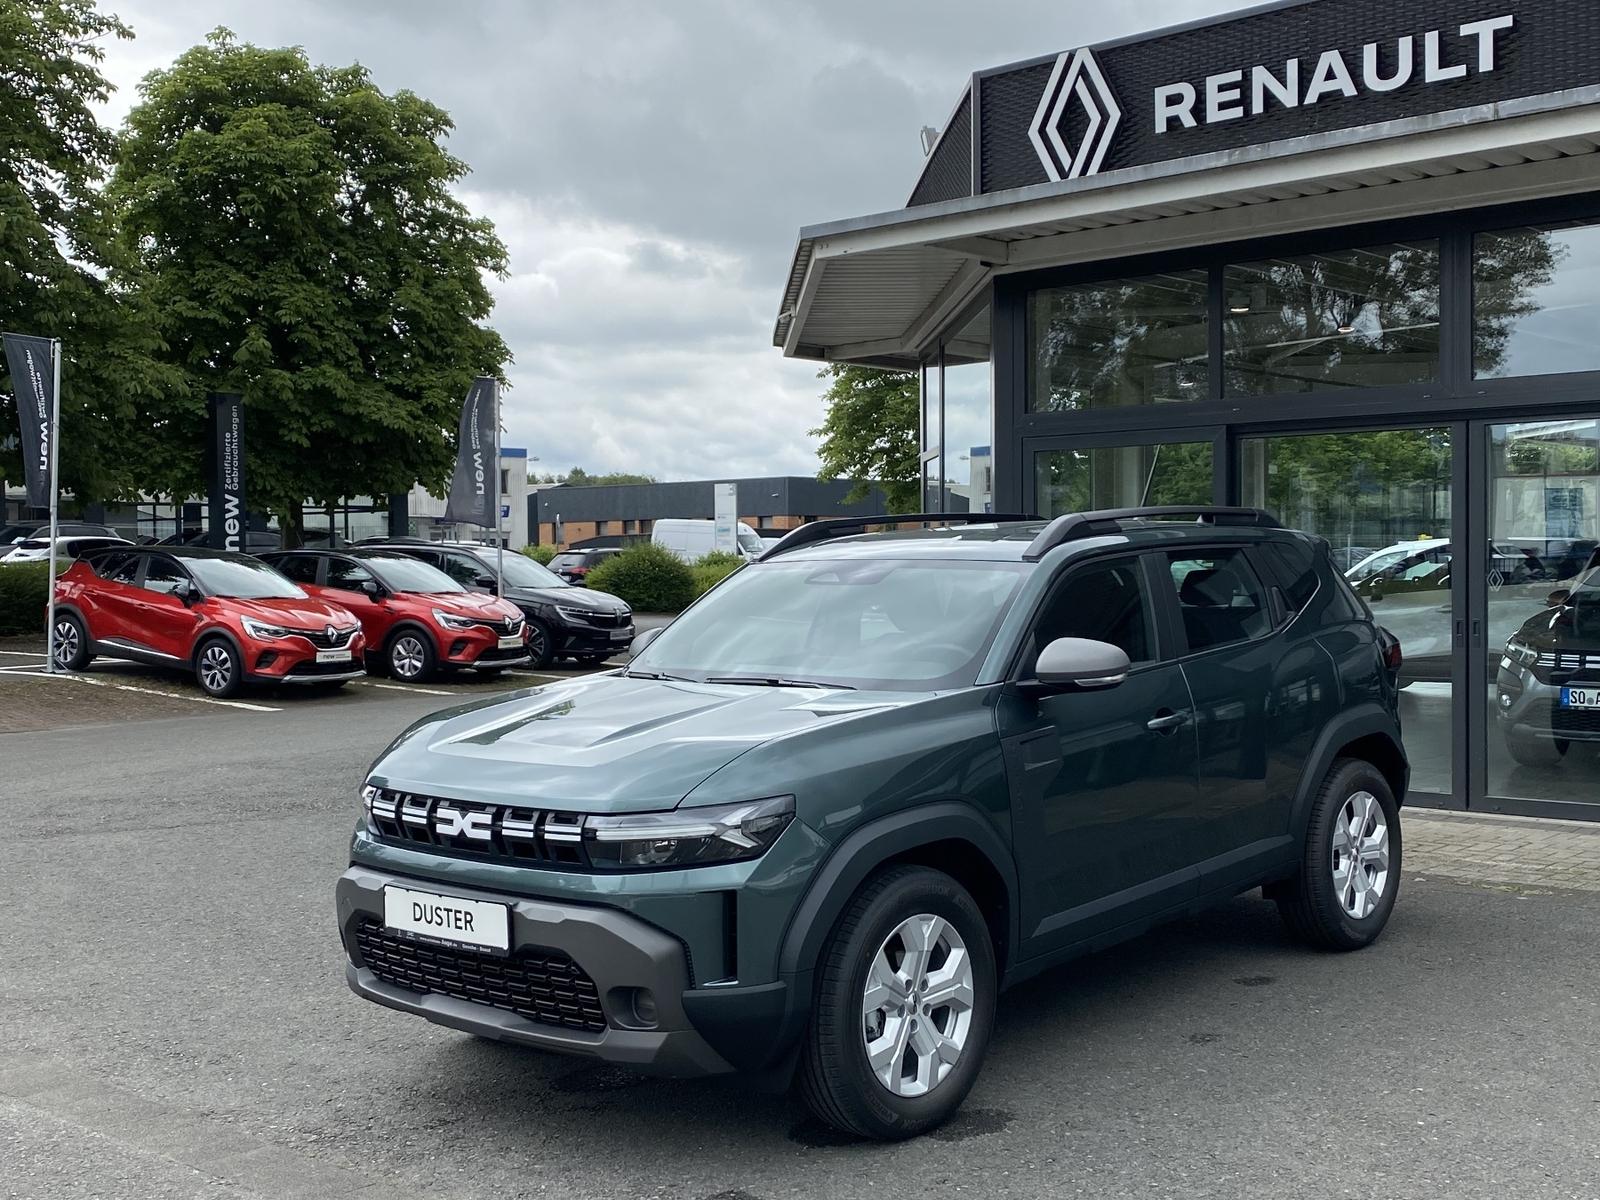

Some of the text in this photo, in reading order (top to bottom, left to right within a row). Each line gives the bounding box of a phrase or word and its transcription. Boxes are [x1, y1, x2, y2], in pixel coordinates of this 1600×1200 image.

[1154, 15, 1513, 134] RENAULT
[225, 494, 239, 551] new
[1570, 690, 1586, 704] SO
[412, 901, 475, 932] DUSTER
